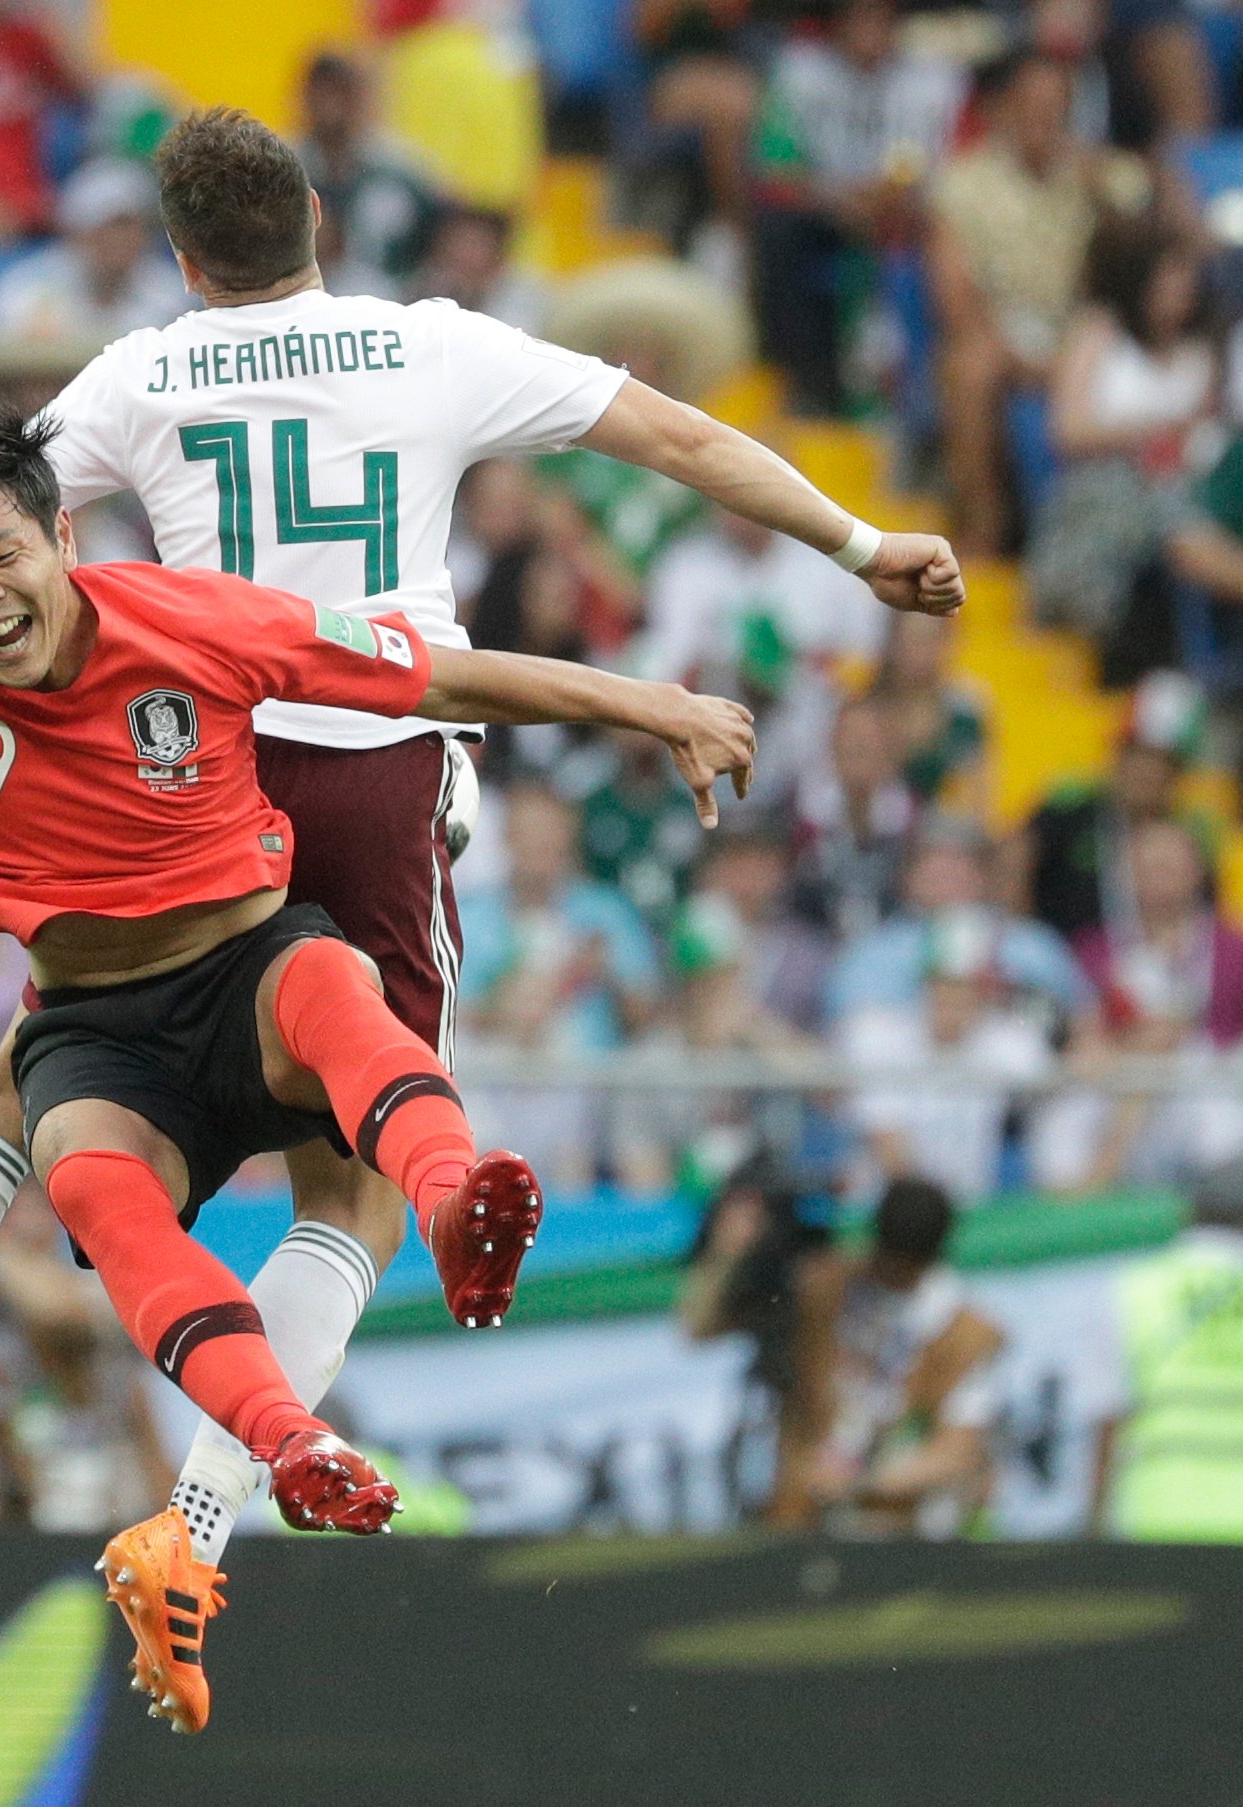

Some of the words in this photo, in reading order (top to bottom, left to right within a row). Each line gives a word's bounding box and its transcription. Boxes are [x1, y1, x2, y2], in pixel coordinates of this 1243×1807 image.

[147, 355, 178, 392] J.
[189, 325, 404, 389] HERNÁNDEZ
[178, 418, 399, 597] 14
